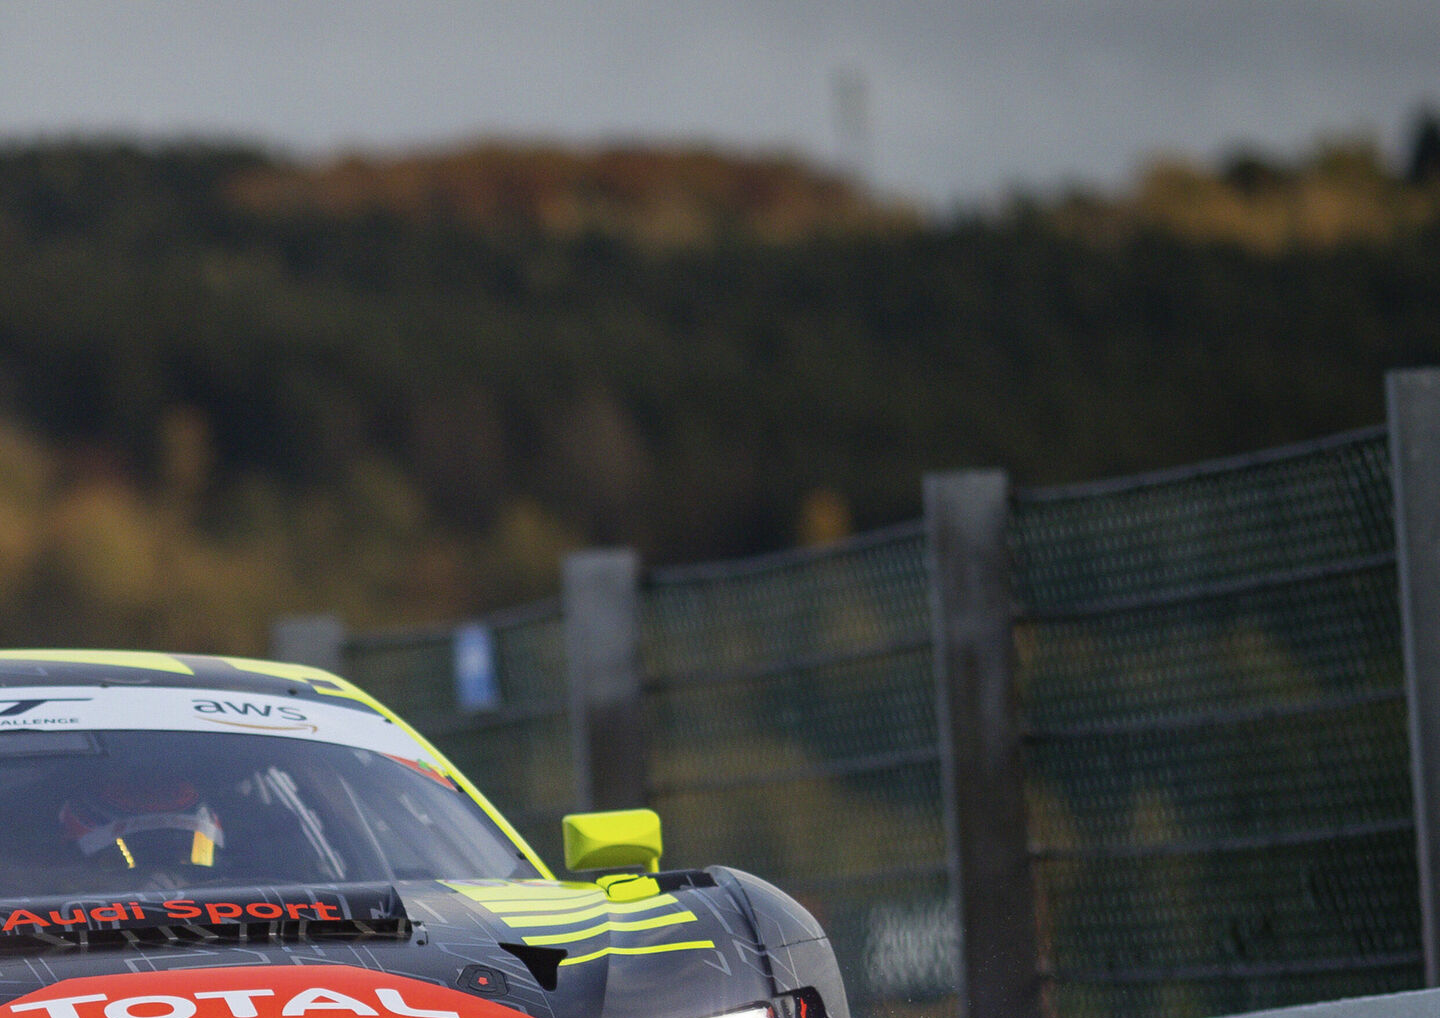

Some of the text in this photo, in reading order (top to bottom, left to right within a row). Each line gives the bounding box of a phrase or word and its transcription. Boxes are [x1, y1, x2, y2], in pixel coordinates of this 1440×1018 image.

[192, 698, 308, 723] aws
[2, 899, 342, 931] Audi Sport
